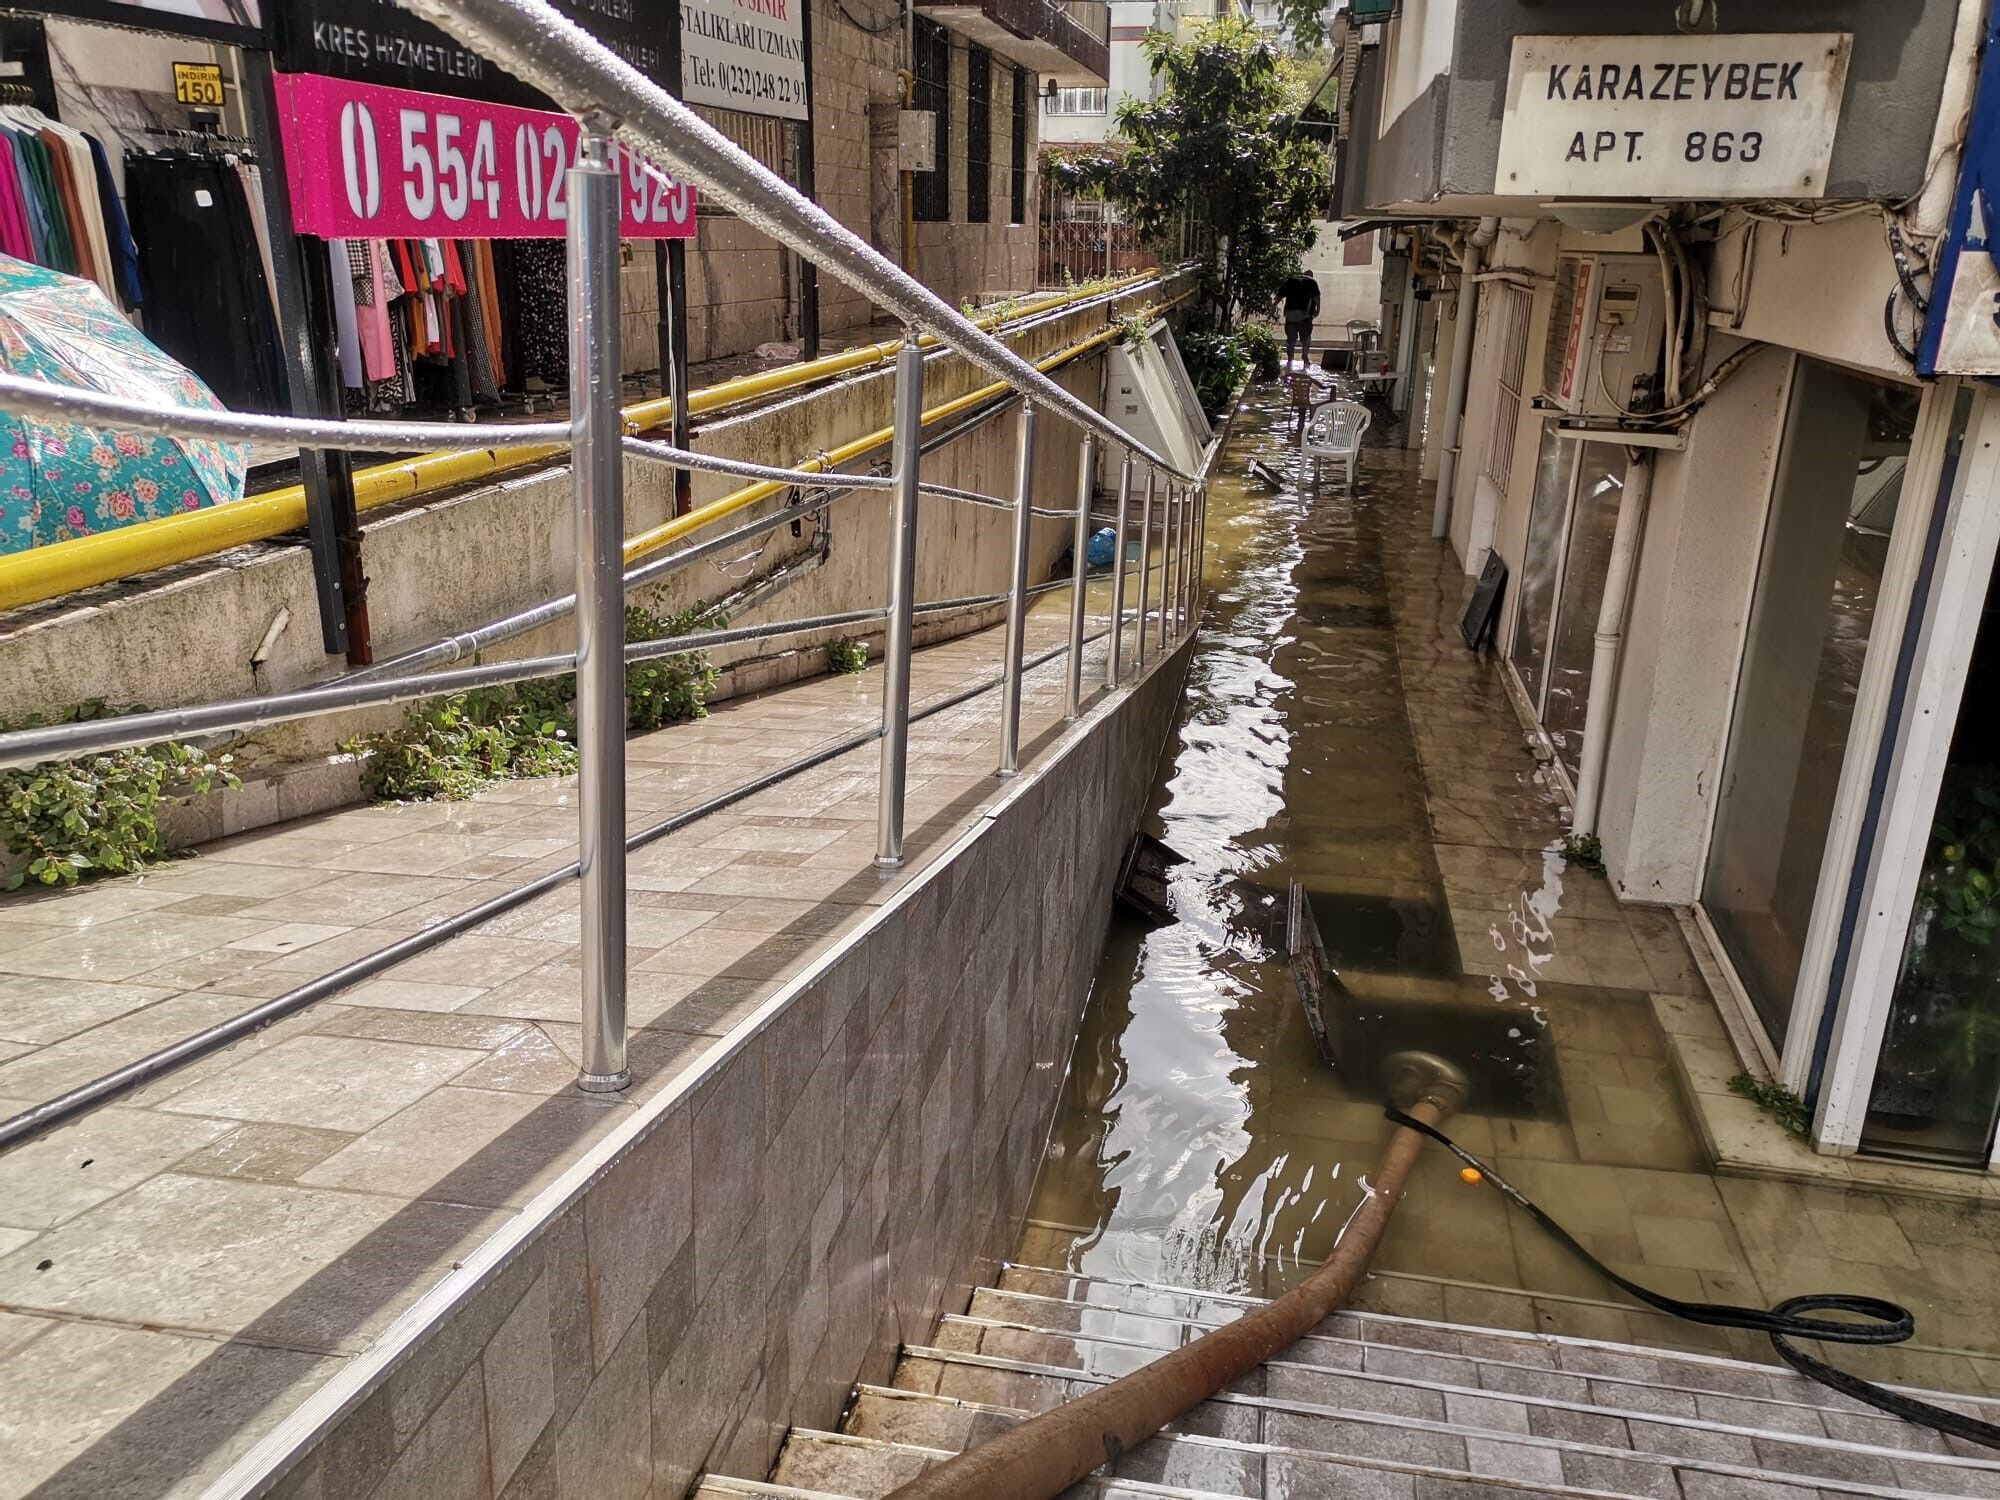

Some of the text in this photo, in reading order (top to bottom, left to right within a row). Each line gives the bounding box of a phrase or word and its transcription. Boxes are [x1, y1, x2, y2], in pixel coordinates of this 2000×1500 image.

[312, 20, 369, 67] KREŞ
[690, 55, 716, 88] Tel:
[718, 62, 775, 103] 0(232)248
[778, 76, 791, 102] 22
[793, 79, 807, 106] 91
[1547, 62, 1804, 101] KARAZEYBEK
[340, 101, 381, 220] 0
[400, 109, 500, 221] 554
[516, 123, 582, 221] 02
[1565, 131, 1763, 162] APT. 863
